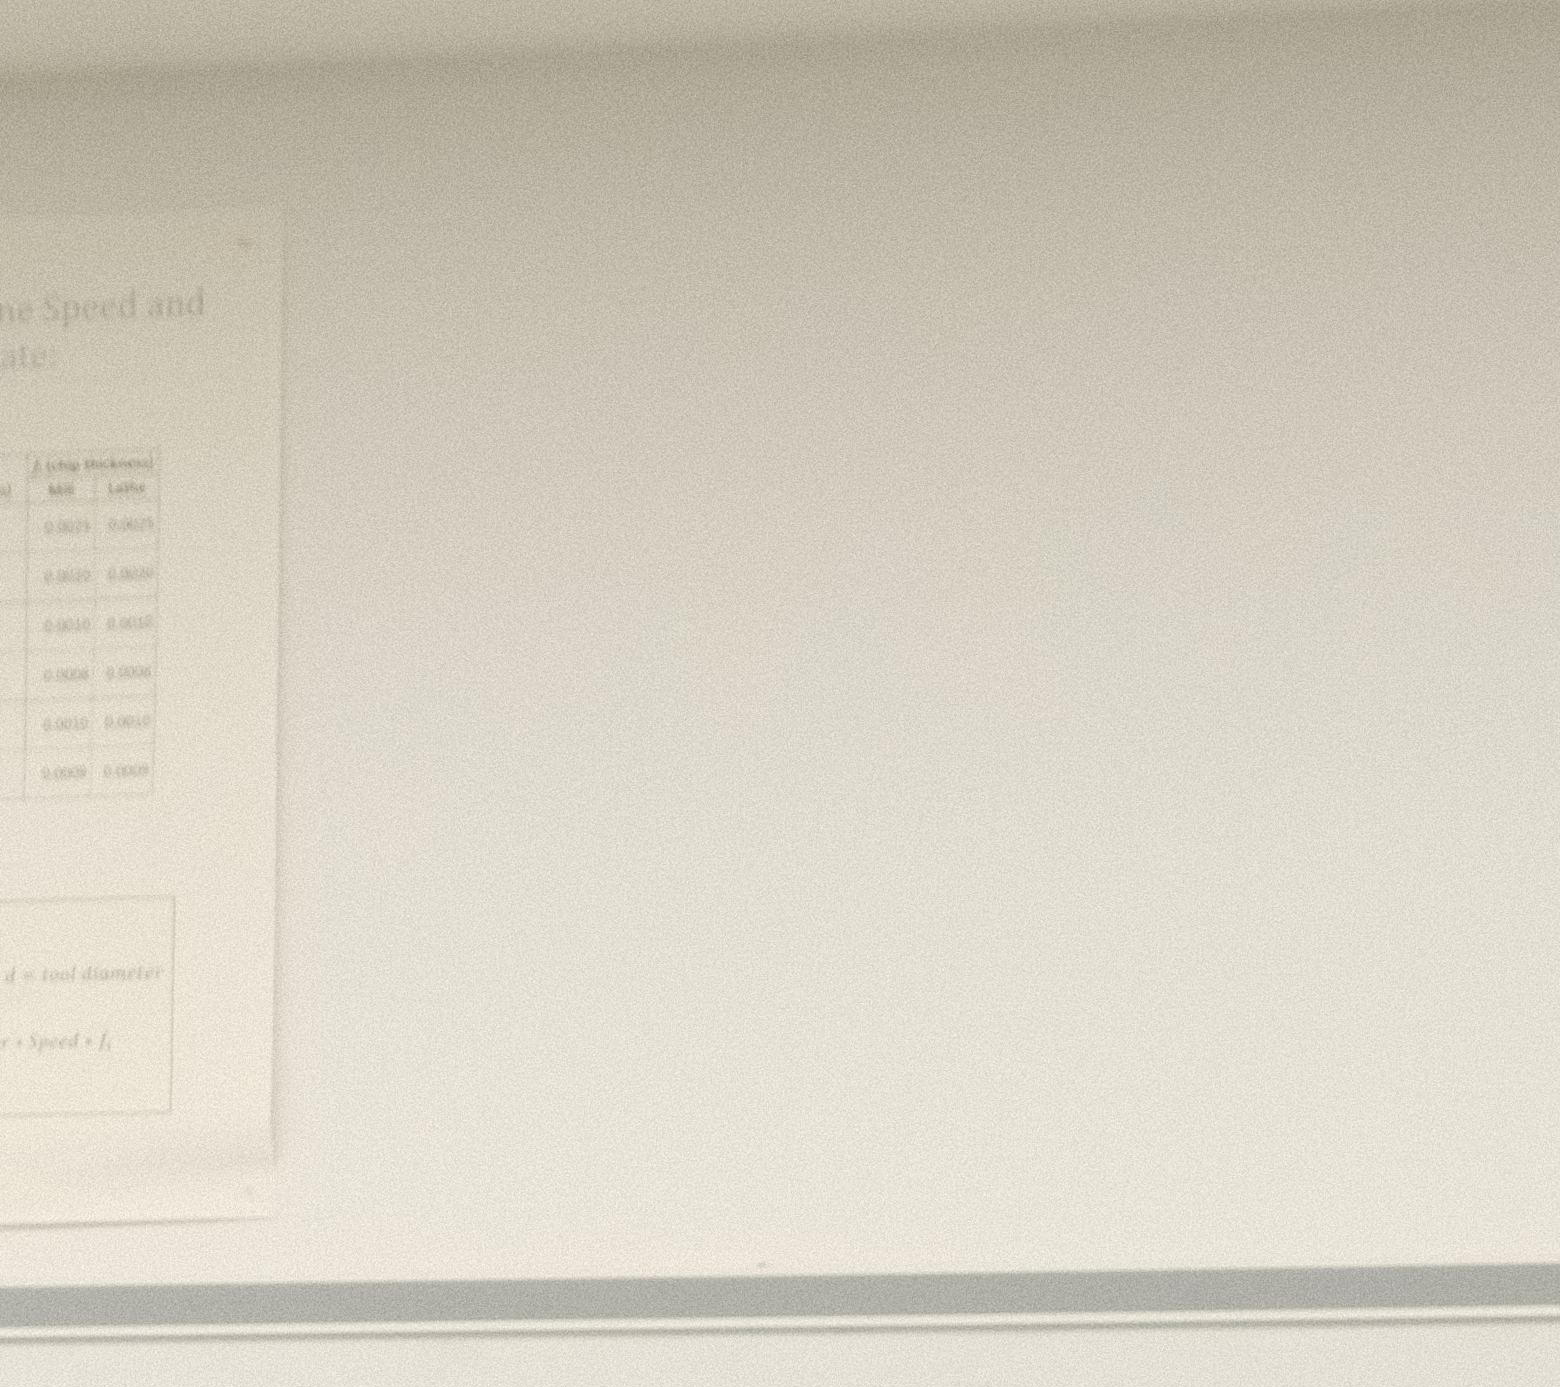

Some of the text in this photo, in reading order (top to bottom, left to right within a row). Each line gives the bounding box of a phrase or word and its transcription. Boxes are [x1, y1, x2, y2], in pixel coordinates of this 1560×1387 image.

[42, 288, 137, 329] Speed
[147, 286, 205, 318] and
[41, 964, 163, 983] tool diameter
